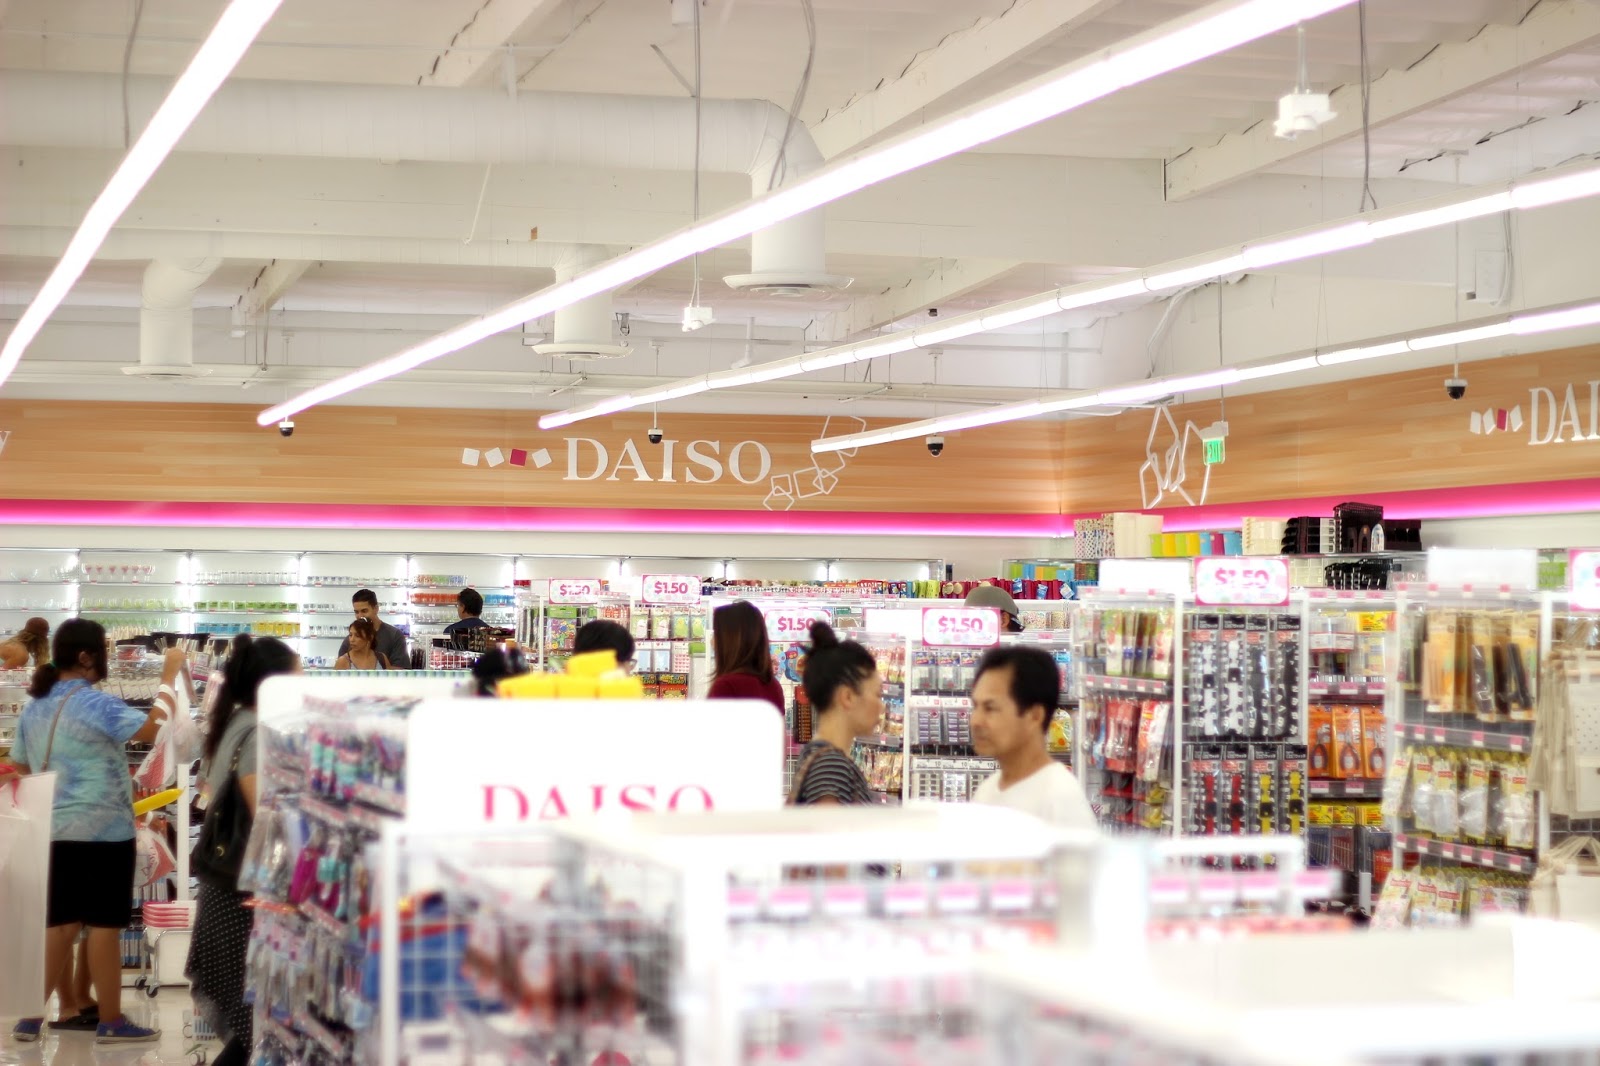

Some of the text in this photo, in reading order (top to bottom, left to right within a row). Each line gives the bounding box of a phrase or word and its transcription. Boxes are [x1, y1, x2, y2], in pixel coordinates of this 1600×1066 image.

[562, 437, 772, 484] DAISO
[654, 580, 689, 595] $1.50
[777, 616, 817, 632] $1.50
[938, 615, 983, 633] $1.50
